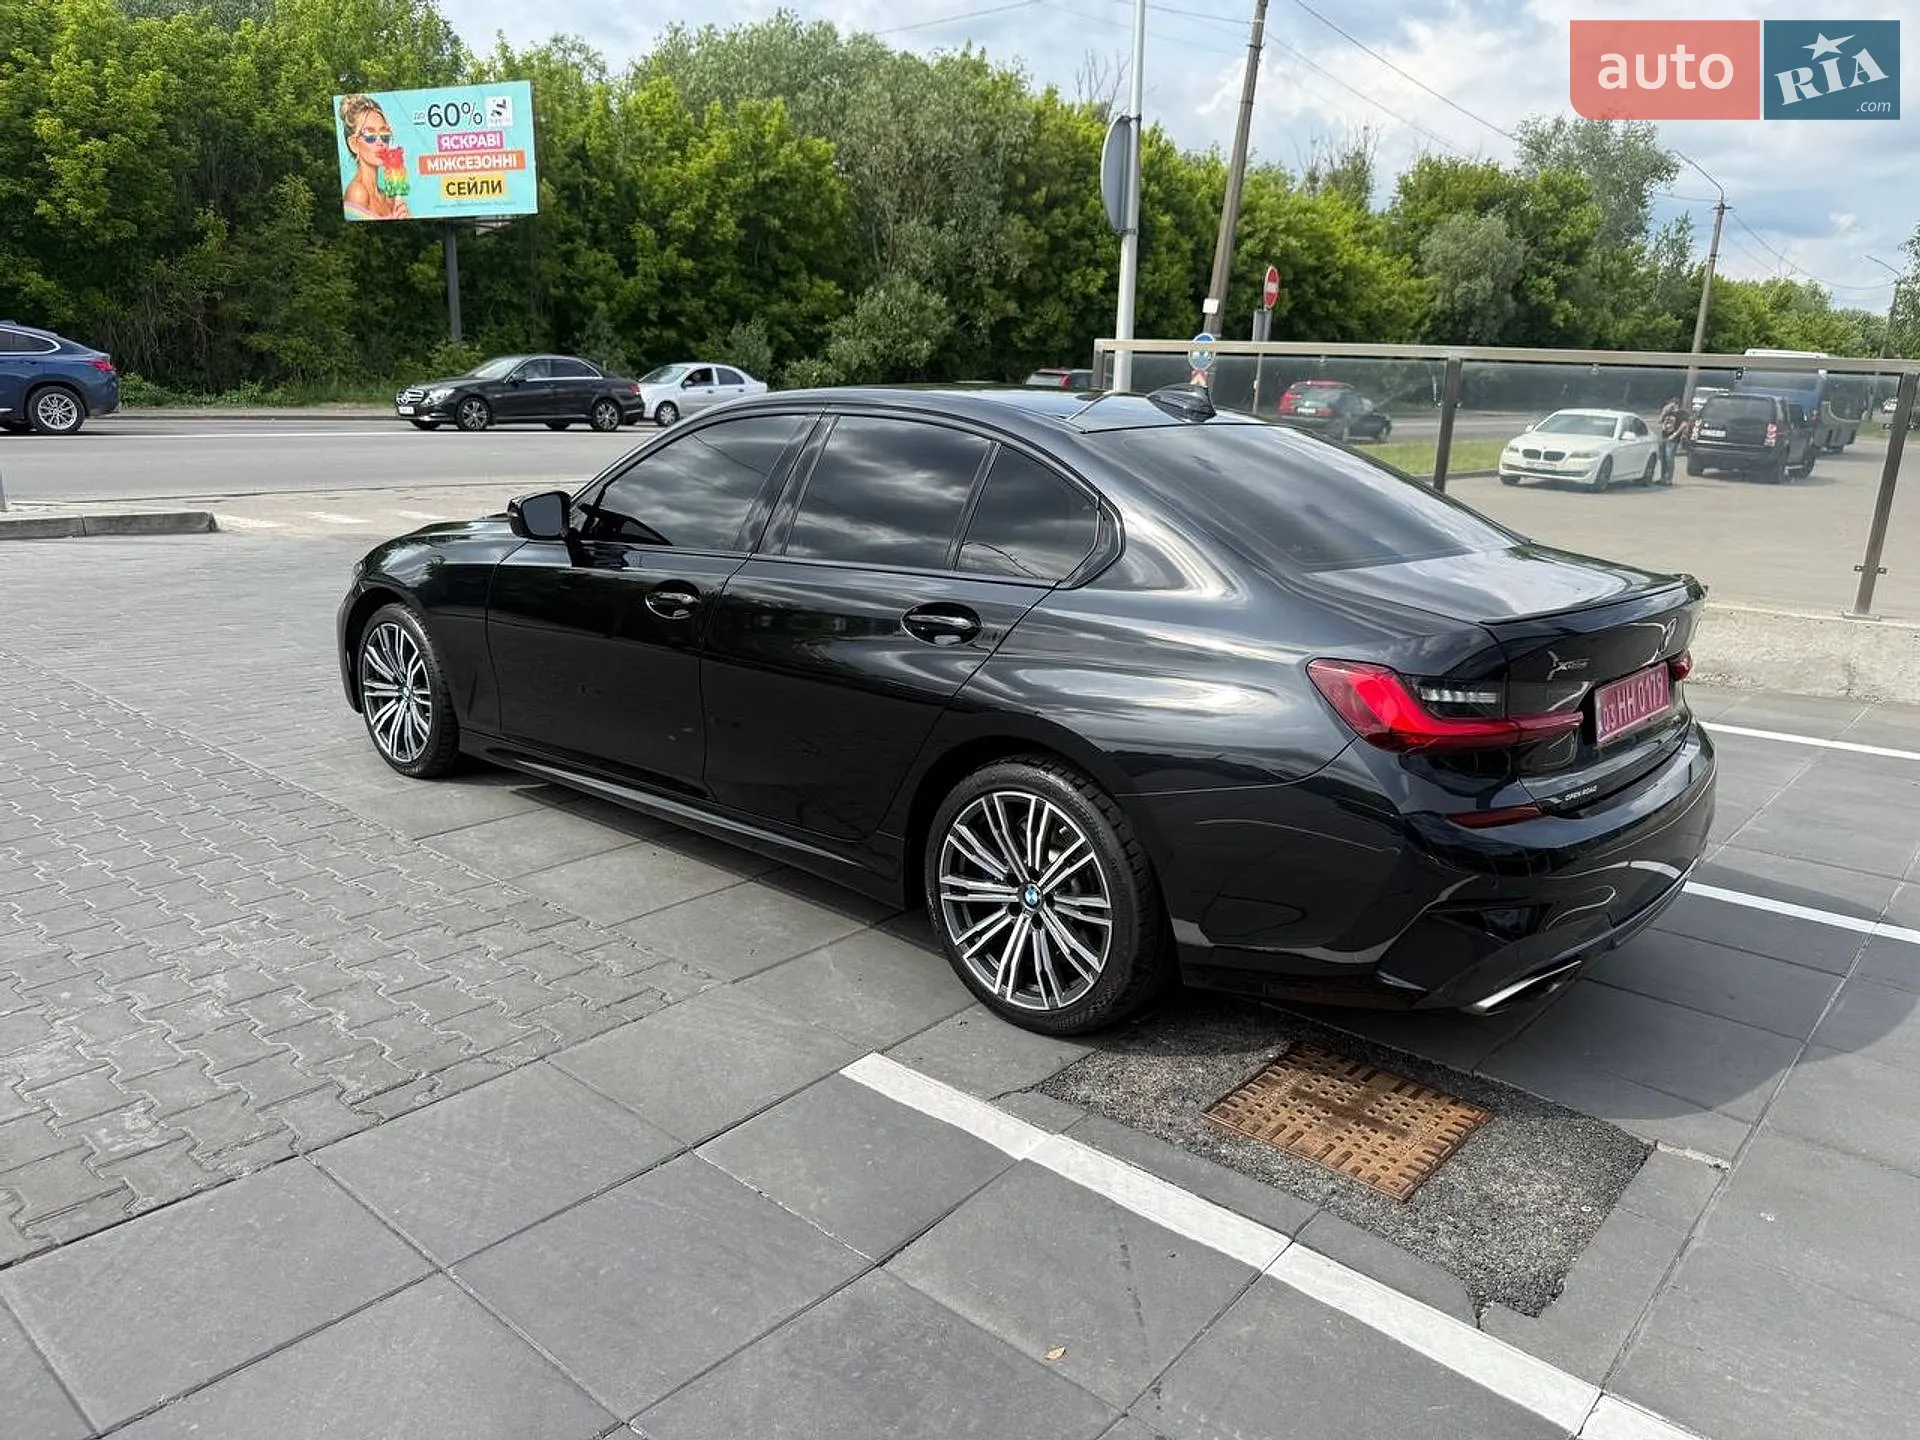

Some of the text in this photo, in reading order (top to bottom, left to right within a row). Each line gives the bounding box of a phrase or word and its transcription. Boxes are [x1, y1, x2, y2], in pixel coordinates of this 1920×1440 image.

[440, 134, 501, 149] ЯСКРАВІ
[427, 156, 517, 170] МІЖСЕЗОННІ
[446, 176, 502, 196] СЕЙЛИ
